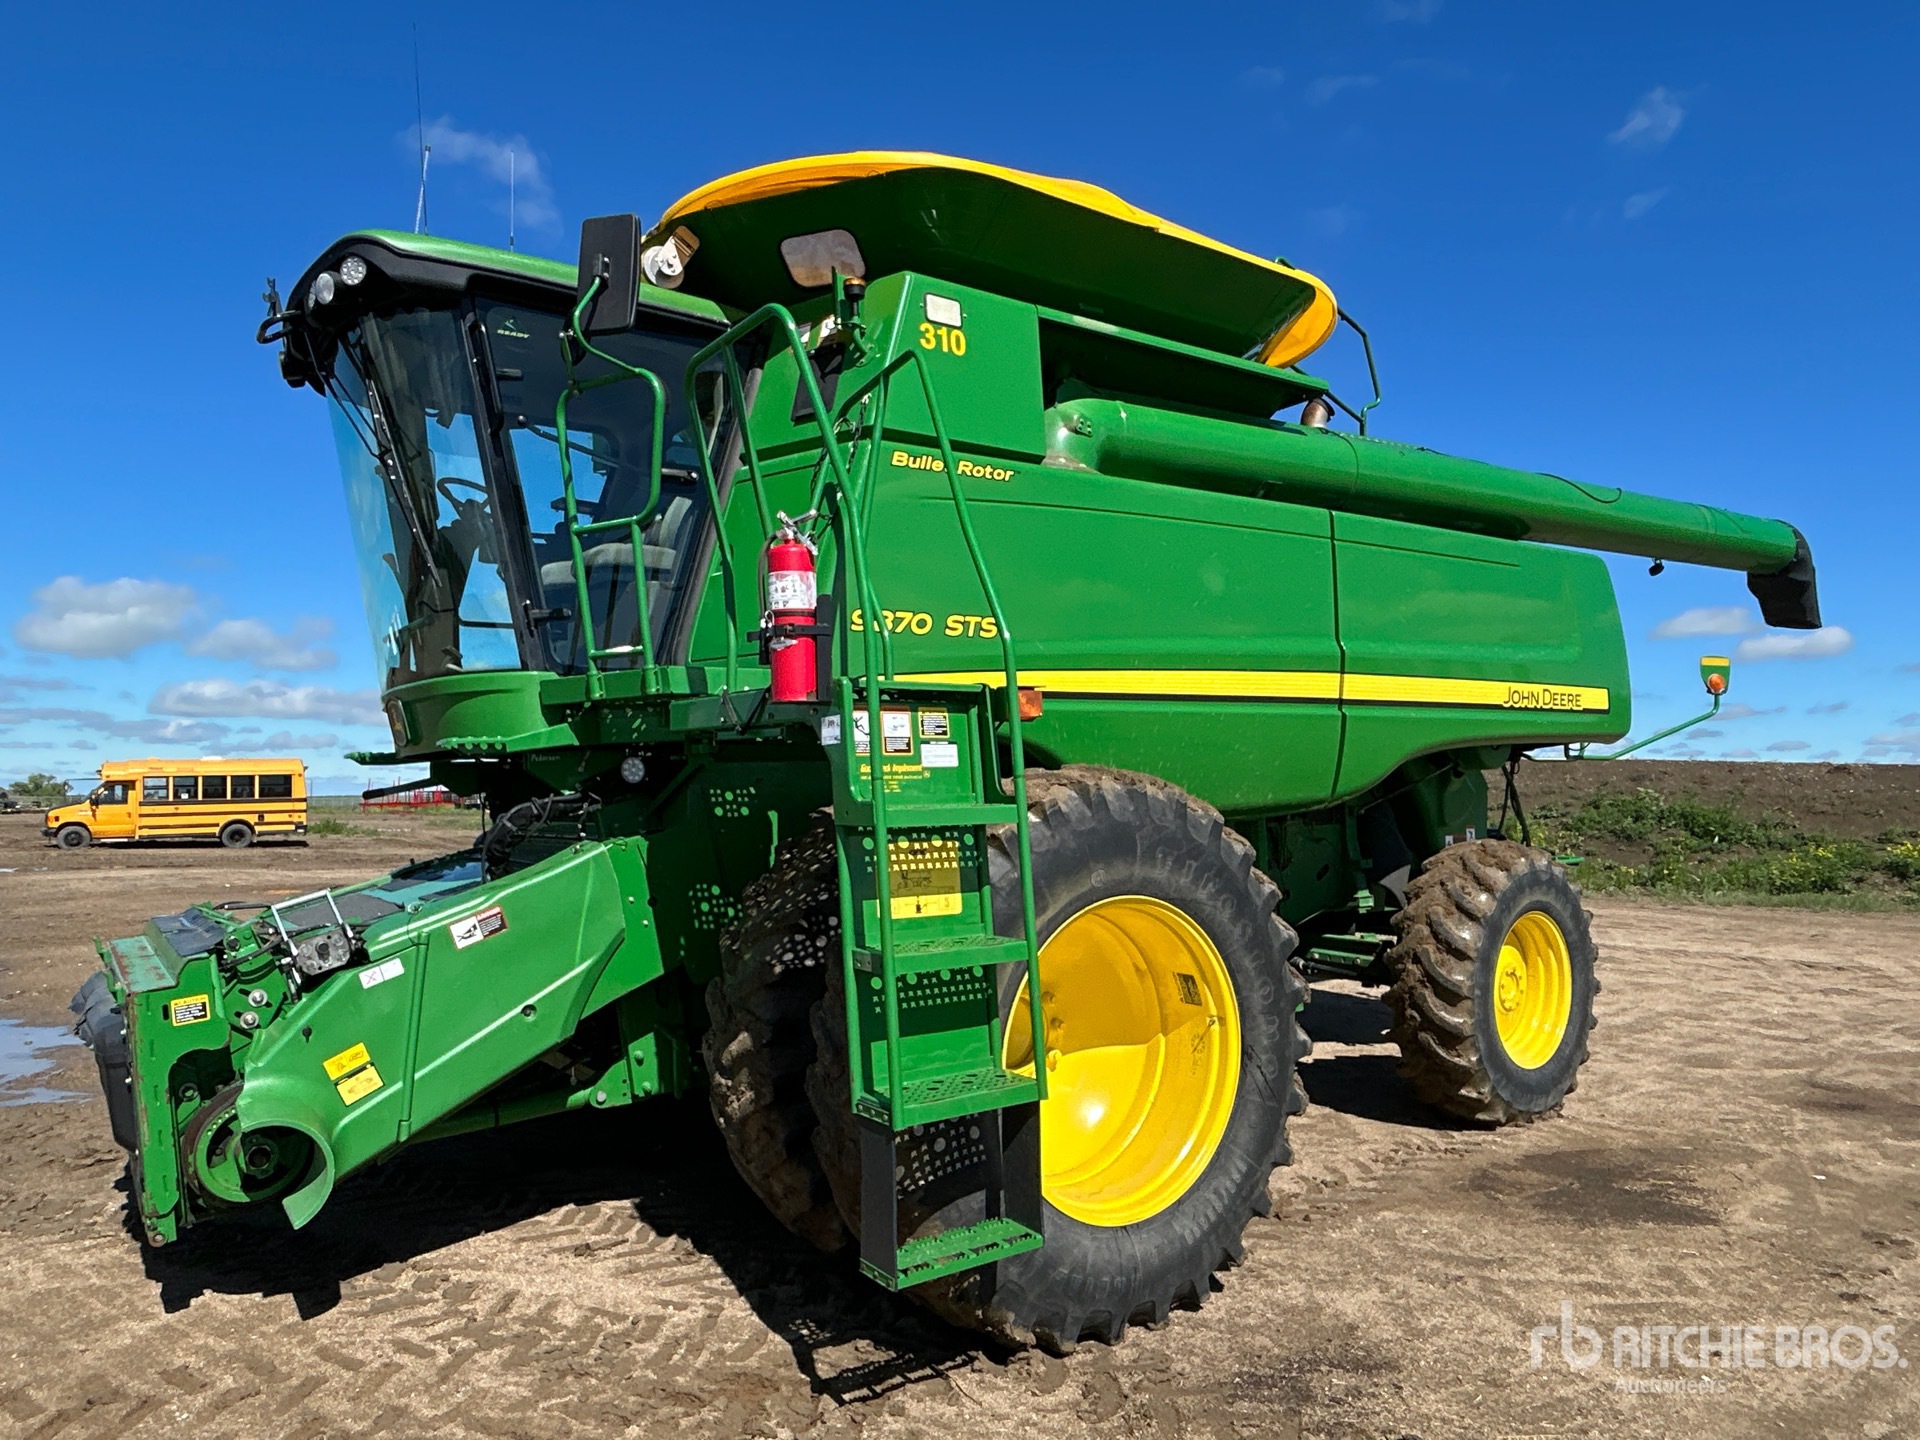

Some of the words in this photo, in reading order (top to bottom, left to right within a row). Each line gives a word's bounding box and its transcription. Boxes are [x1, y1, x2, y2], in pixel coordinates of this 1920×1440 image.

[920, 323, 966, 356] 310
[892, 451, 948, 472] Bulle
[957, 460, 1014, 481] Rotor
[944, 614, 998, 638] STS
[1503, 686, 1540, 706] JOHN
[1542, 688, 1582, 708] DEERE
